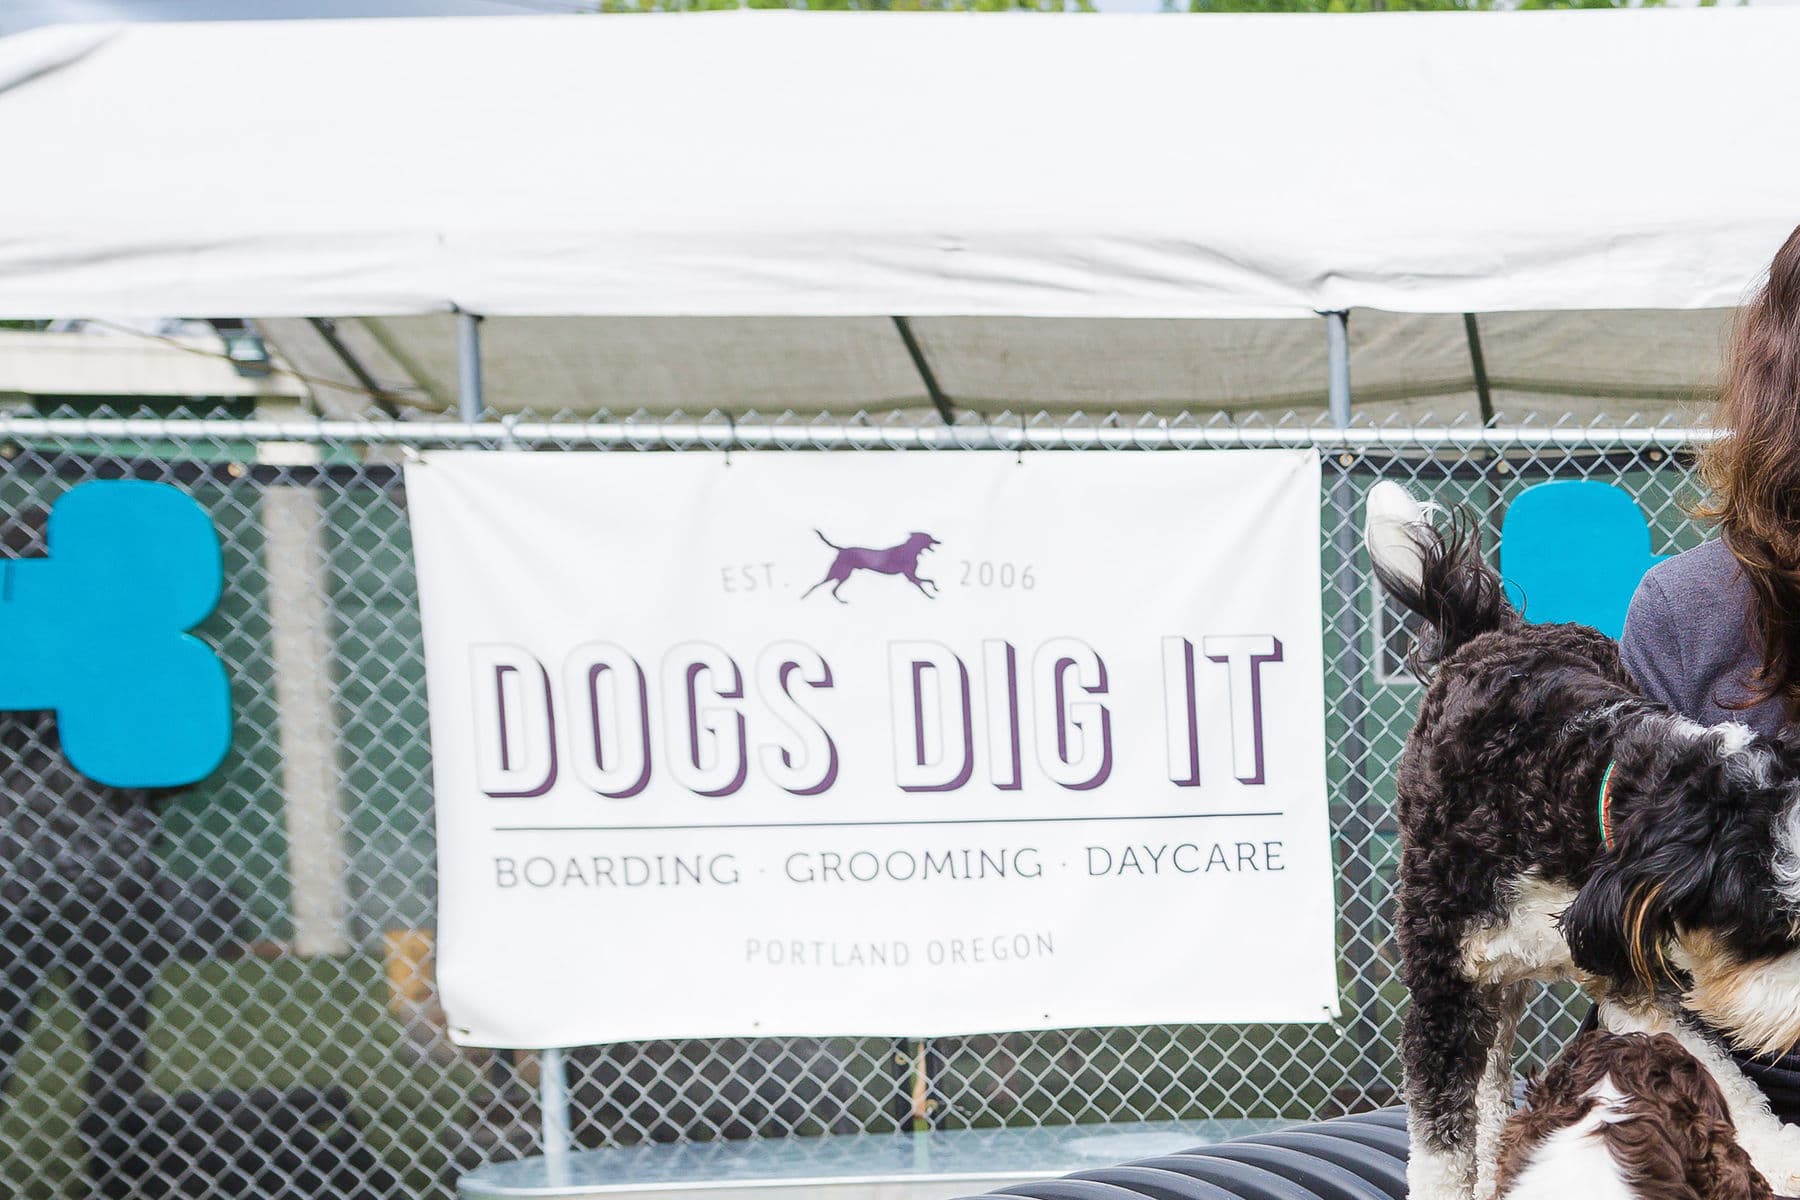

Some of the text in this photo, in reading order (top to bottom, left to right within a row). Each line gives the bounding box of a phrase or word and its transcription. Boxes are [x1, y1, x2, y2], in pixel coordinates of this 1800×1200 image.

[720, 559, 1036, 593] EST. 2006
[468, 633, 1284, 799] DOGS DIG IT
[493, 840, 1286, 889] BOARDING GROOMING DAYCARE
[745, 929, 1056, 968] PORTLAND OREGON
